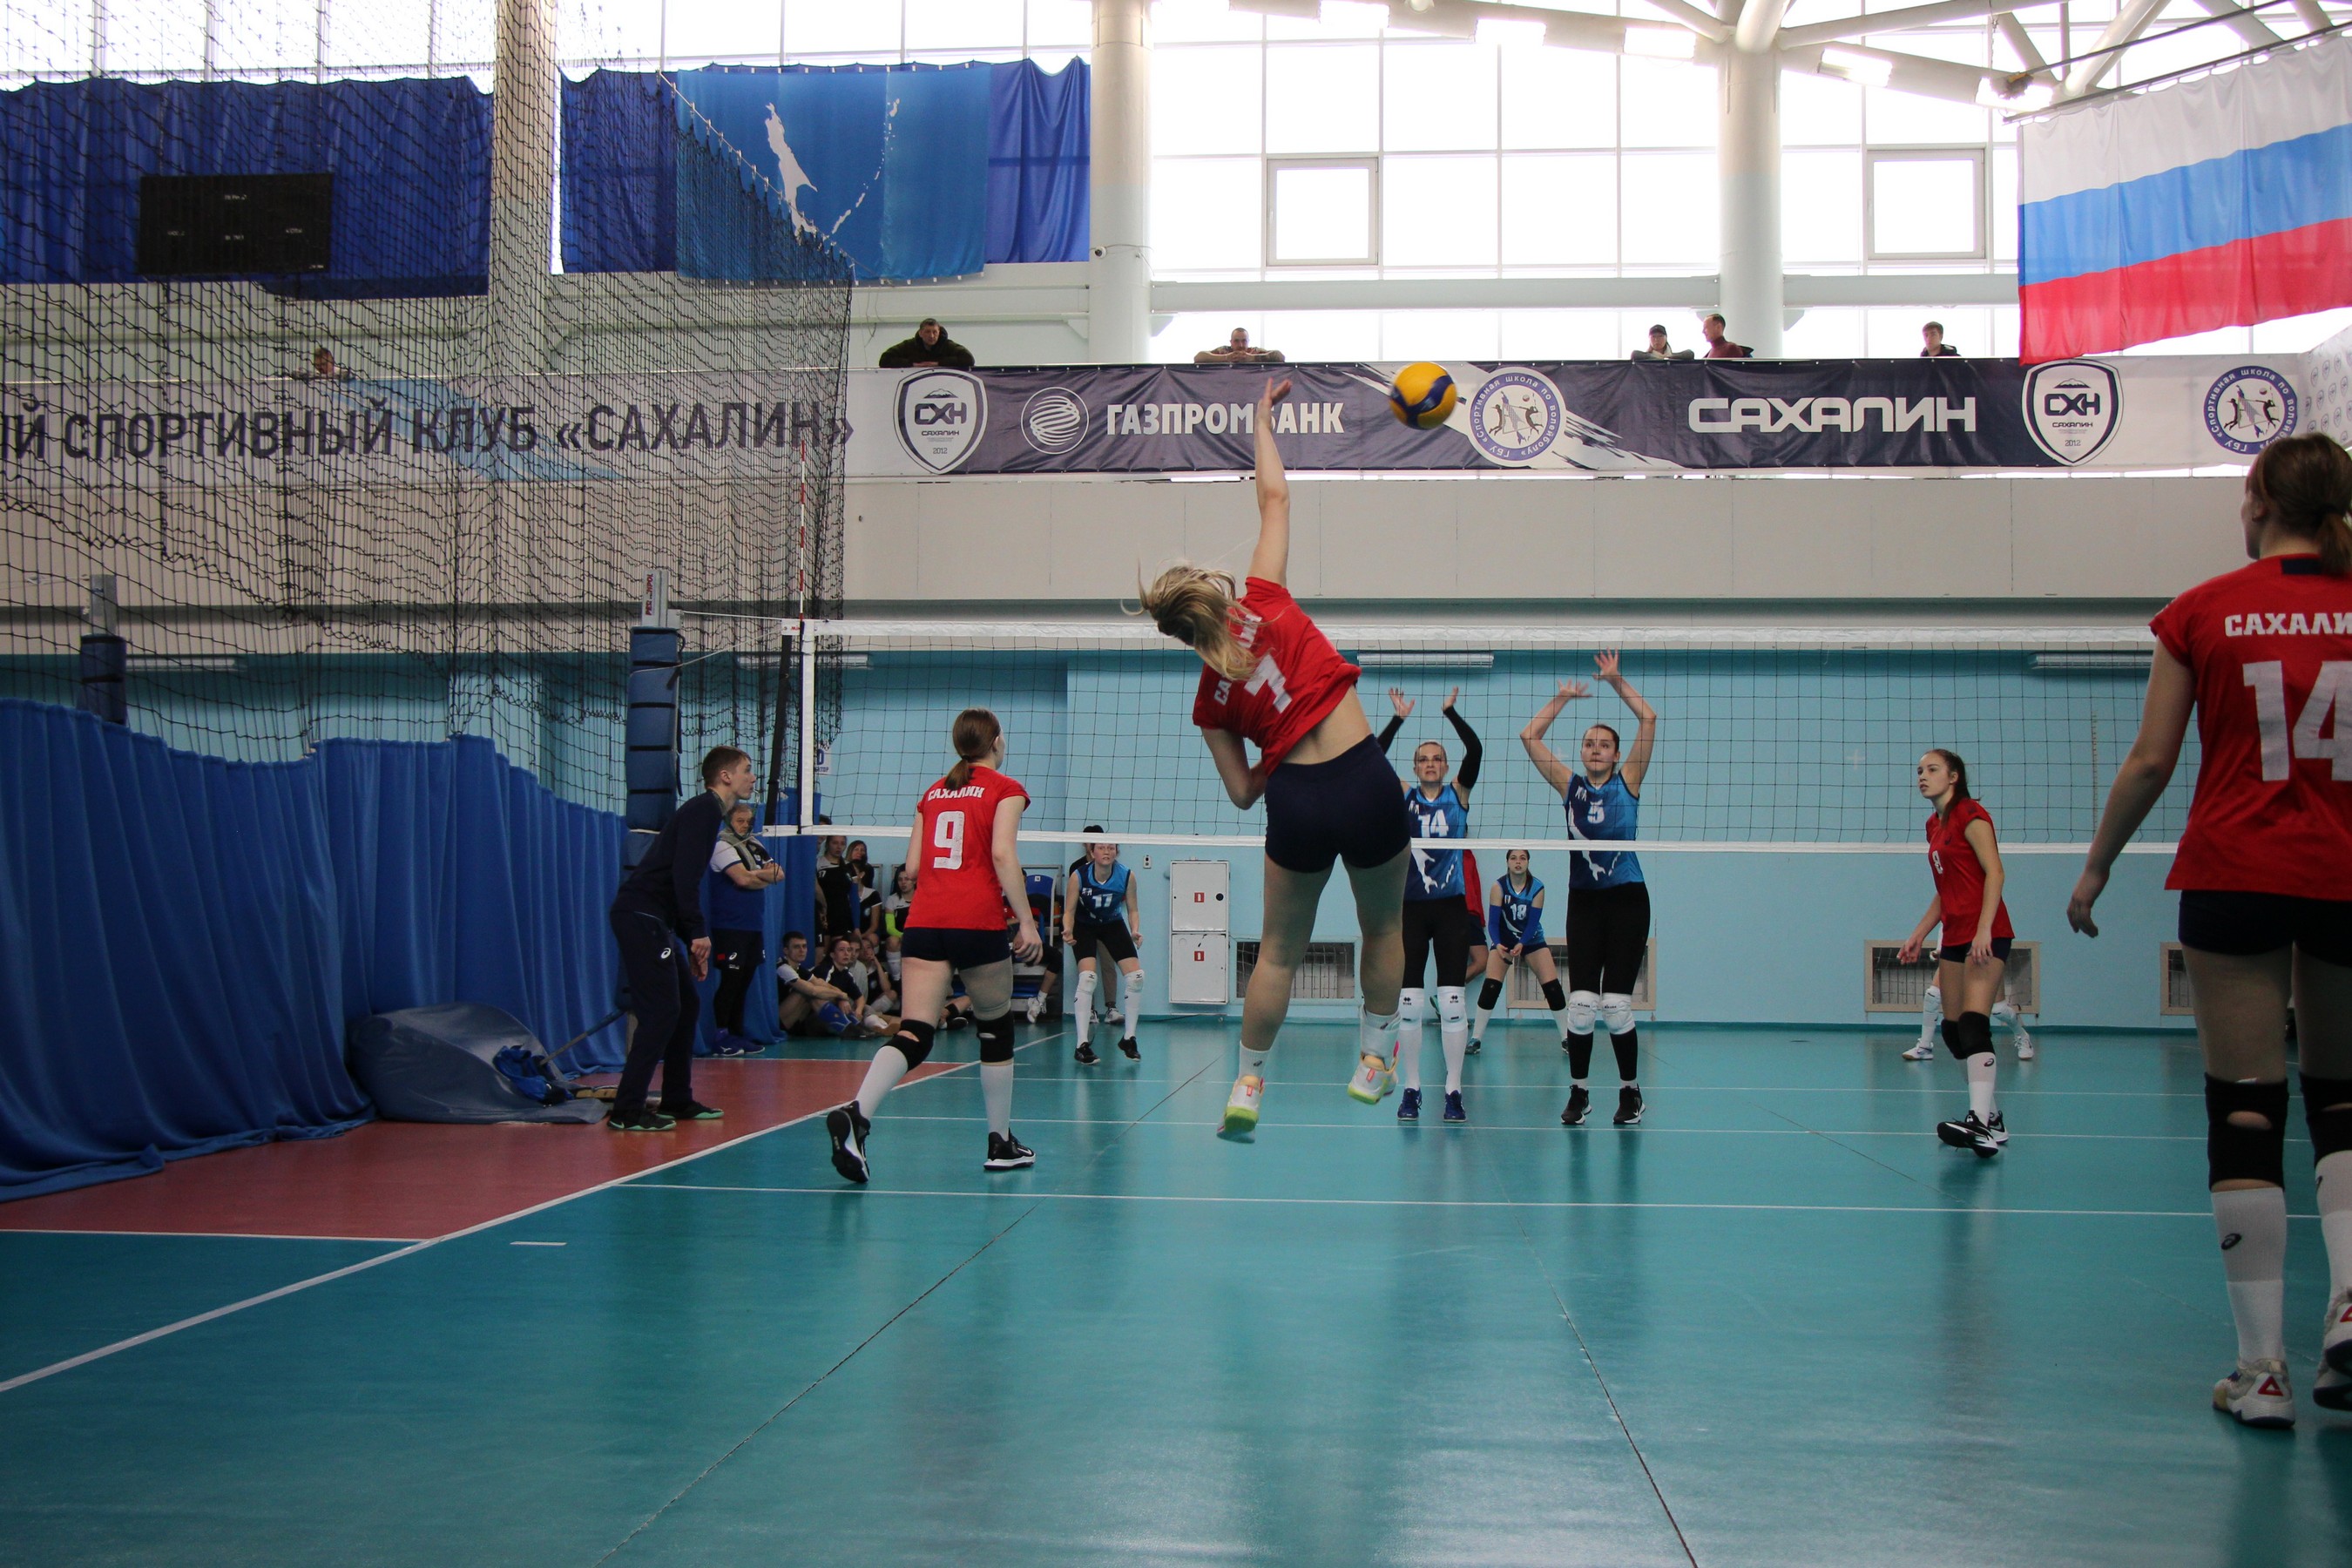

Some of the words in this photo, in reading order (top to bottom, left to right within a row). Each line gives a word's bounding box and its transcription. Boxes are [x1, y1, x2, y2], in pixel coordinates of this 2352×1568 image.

[64, 397, 390, 459] СПОРТИВНЫЙ
[412, 407, 538, 454] КЛУБ
[558, 402, 854, 452] «САХАЛИН»
[1106, 402, 1345, 435] ГАЗПРОМАНК
[1688, 396, 1976, 433] САХАЛИН
[1244, 653, 1293, 714] 7
[2242, 660, 2352, 782] 14
[928, 786, 985, 801] САХАЛИН
[1418, 809, 1449, 838] 14
[1587, 799, 1605, 824] 5
[934, 810, 964, 870] 9
[1511, 903, 1527, 921] 18
